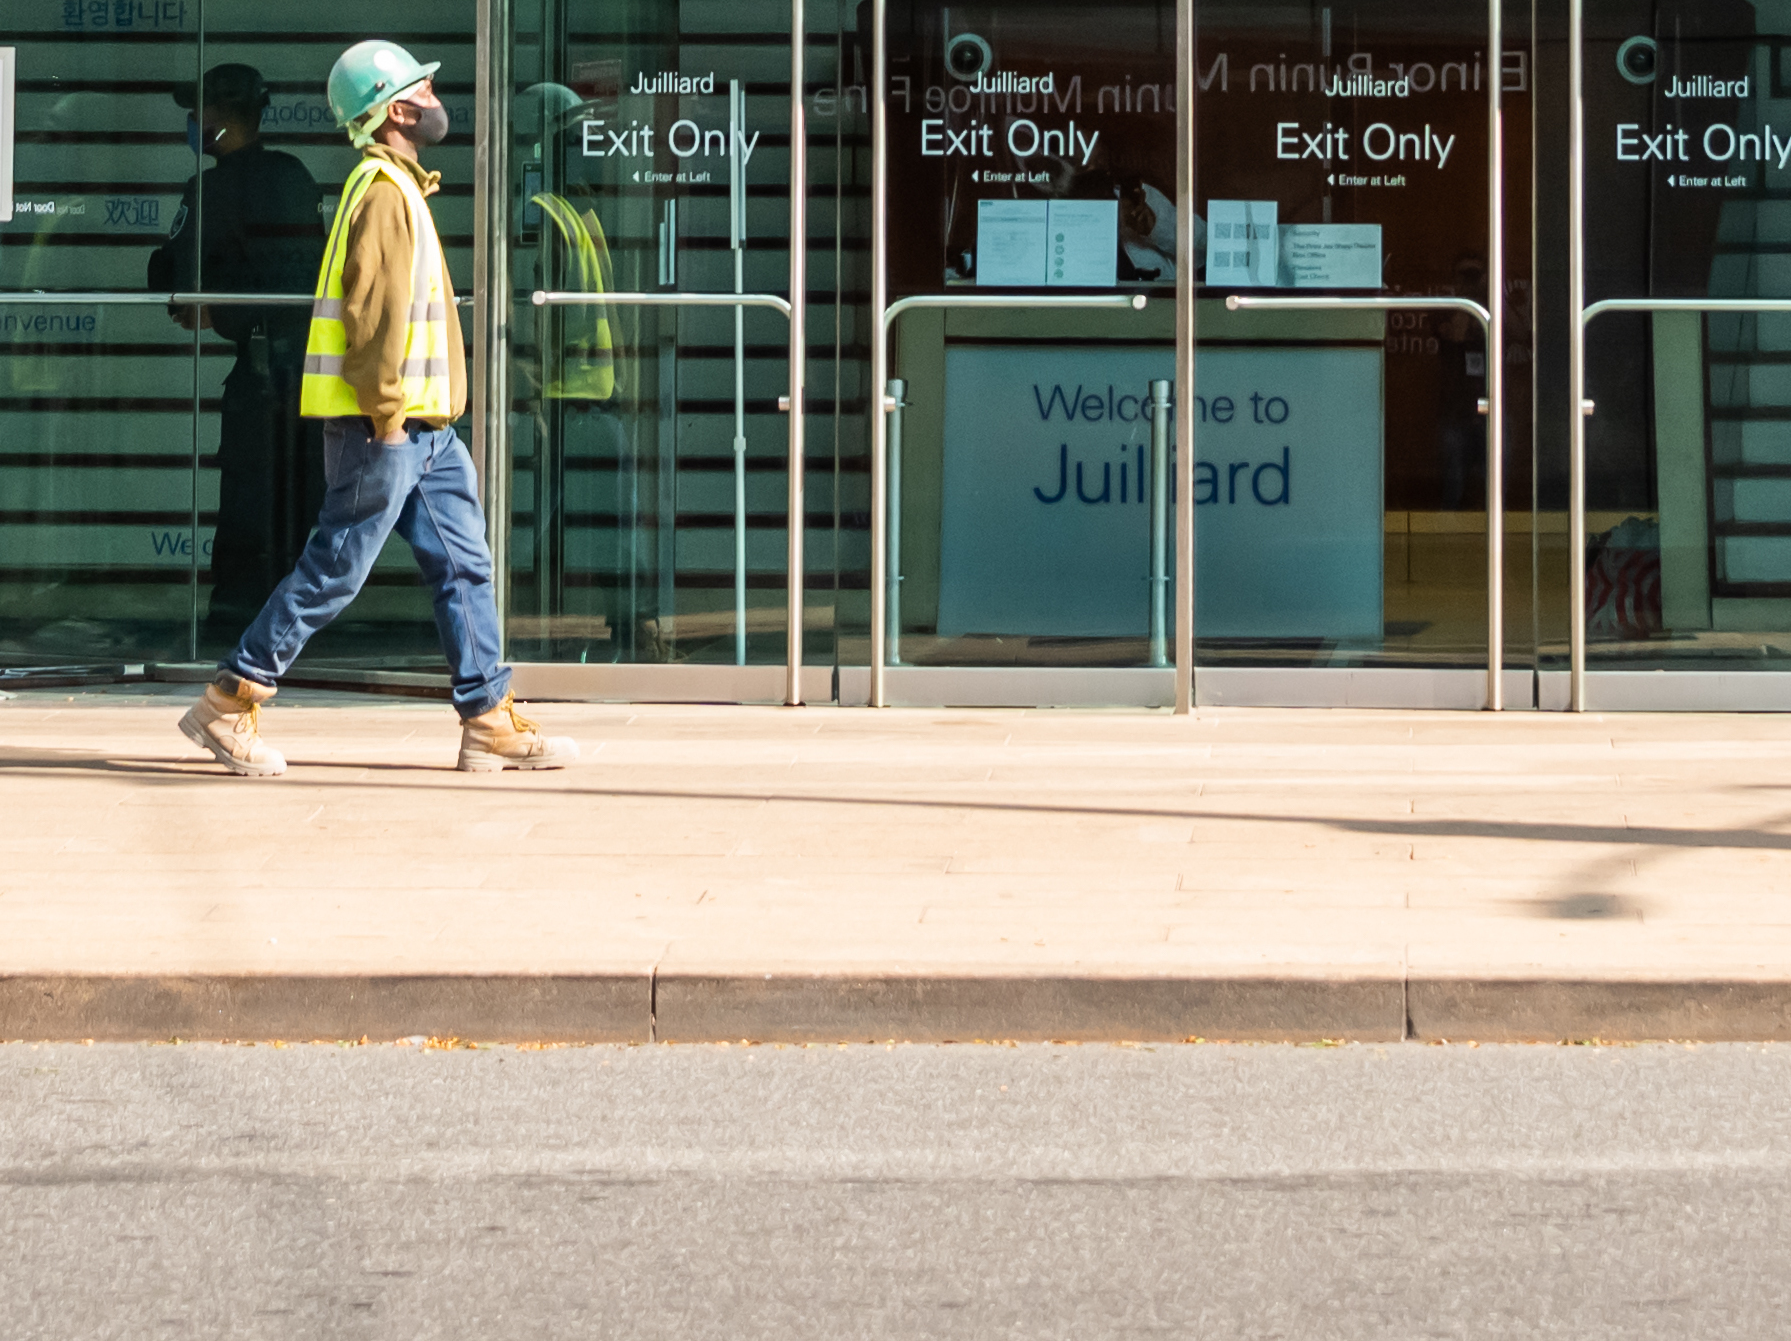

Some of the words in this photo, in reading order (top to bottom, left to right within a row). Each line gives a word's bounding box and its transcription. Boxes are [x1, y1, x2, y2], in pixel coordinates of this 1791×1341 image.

[630, 71, 714, 94] Juilliard
[969, 71, 1054, 94] Juilliard
[1324, 74, 1409, 97] Juilliard
[1664, 75, 1749, 98] Juilliard
[582, 120, 654, 157] Exit
[668, 119, 760, 165] Only
[921, 119, 994, 157] Exit
[1007, 119, 1099, 166] Only
[1276, 122, 1350, 160] Exit
[1363, 122, 1456, 169] Only
[1616, 123, 1690, 161] Exit
[644, 171, 673, 183] Enter
[676, 171, 687, 183] at
[689, 170, 710, 183] Left
[983, 170, 1012, 183] Enter
[1014, 171, 1025, 183] at
[1028, 170, 1050, 183] Left
[1338, 174, 1368, 186] Enter
[1370, 174, 1381, 186] at
[1384, 174, 1406, 186] Left
[1678, 175, 1708, 187] Enter
[1710, 176, 1721, 187] at
[1724, 175, 1747, 187] Left
[104, 197, 160, 226] 欢迎
[1249, 391, 1290, 424] to
[1032, 443, 1291, 505] Juiliard
